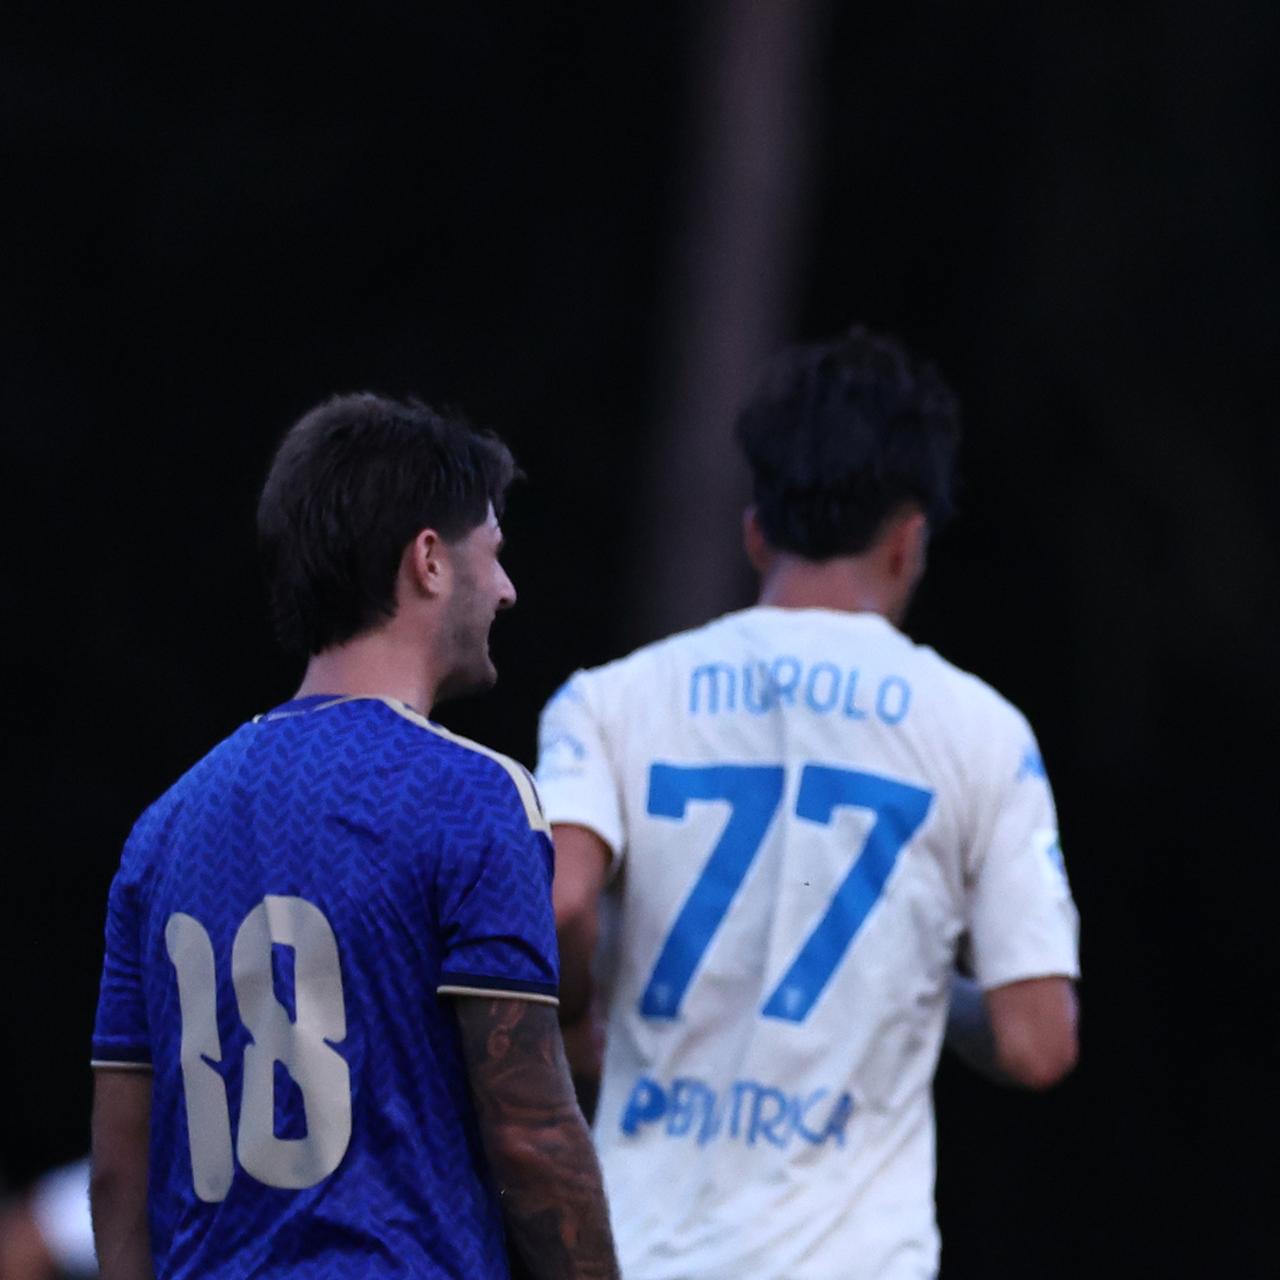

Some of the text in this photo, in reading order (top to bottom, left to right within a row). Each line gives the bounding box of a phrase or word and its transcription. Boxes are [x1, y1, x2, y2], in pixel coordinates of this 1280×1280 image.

[690, 655, 911, 726] MUROLO
[640, 763, 935, 1023] 77
[165, 894, 352, 1203] 18
